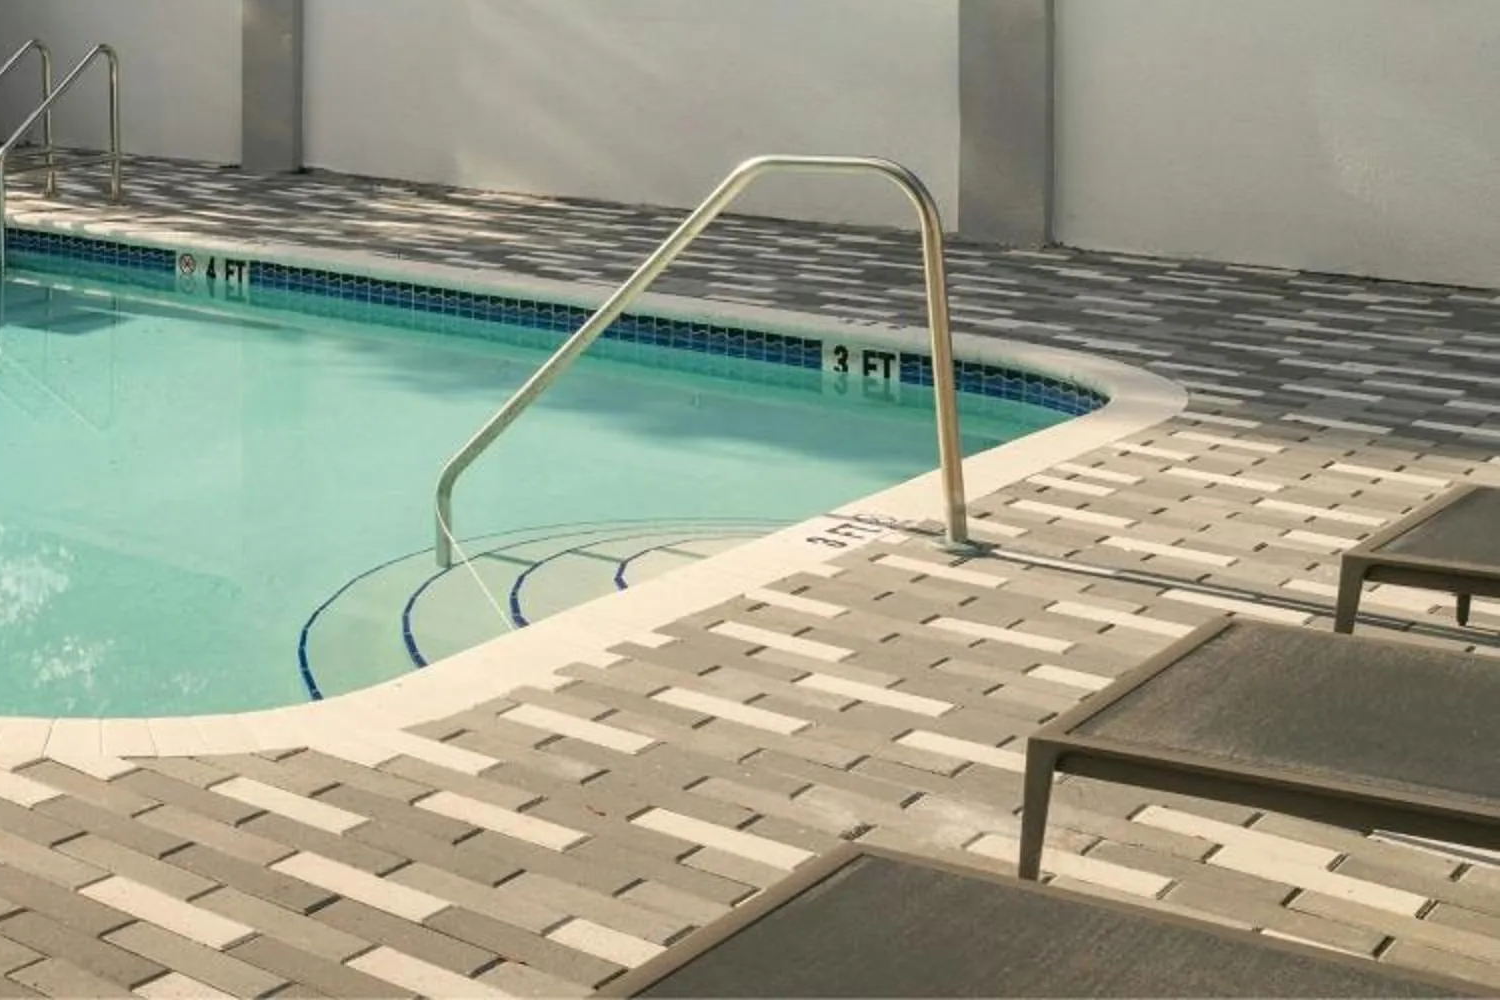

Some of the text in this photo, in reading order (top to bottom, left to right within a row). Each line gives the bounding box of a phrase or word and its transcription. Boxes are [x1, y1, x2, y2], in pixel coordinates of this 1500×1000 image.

[206, 256, 245, 282] 4 FT
[833, 344, 896, 378] 3 FT
[806, 536, 847, 548] 3
